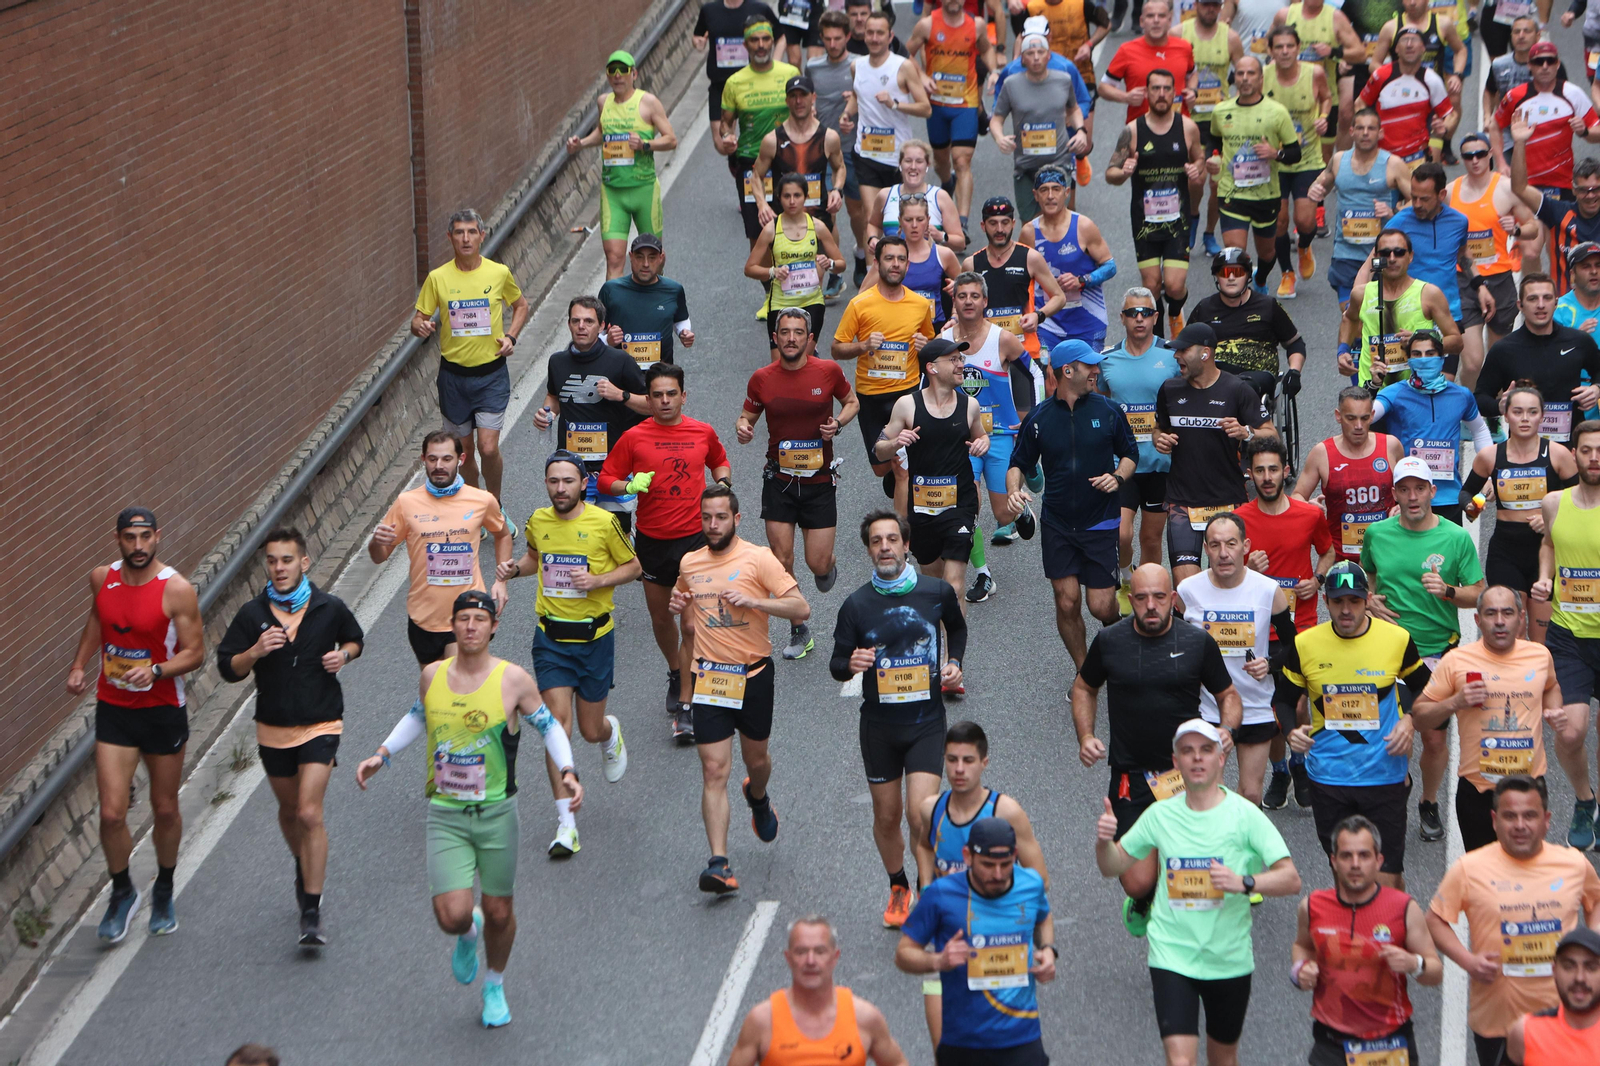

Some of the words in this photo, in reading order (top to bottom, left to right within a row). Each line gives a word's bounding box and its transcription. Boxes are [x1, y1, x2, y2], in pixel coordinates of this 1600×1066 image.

[1467, 231, 1490, 239] ZURICH
[790, 262, 812, 270] ZURICH
[882, 342, 904, 350] ZURICH
[962, 379, 990, 387] RANADA
[1346, 486, 1380, 505] 360
[1573, 568, 1600, 578] ZURICH
[894, 657, 922, 666] ZURICH
[714, 664, 742, 672] ZURICH
[712, 677, 728, 685] 6221
[1342, 700, 1360, 708] 6127
[450, 756, 478, 764] ZURICH
[1184, 860, 1211, 868] ZURIC
[1522, 922, 1556, 932] ZURICH
[989, 936, 1022, 946] ZURICH
